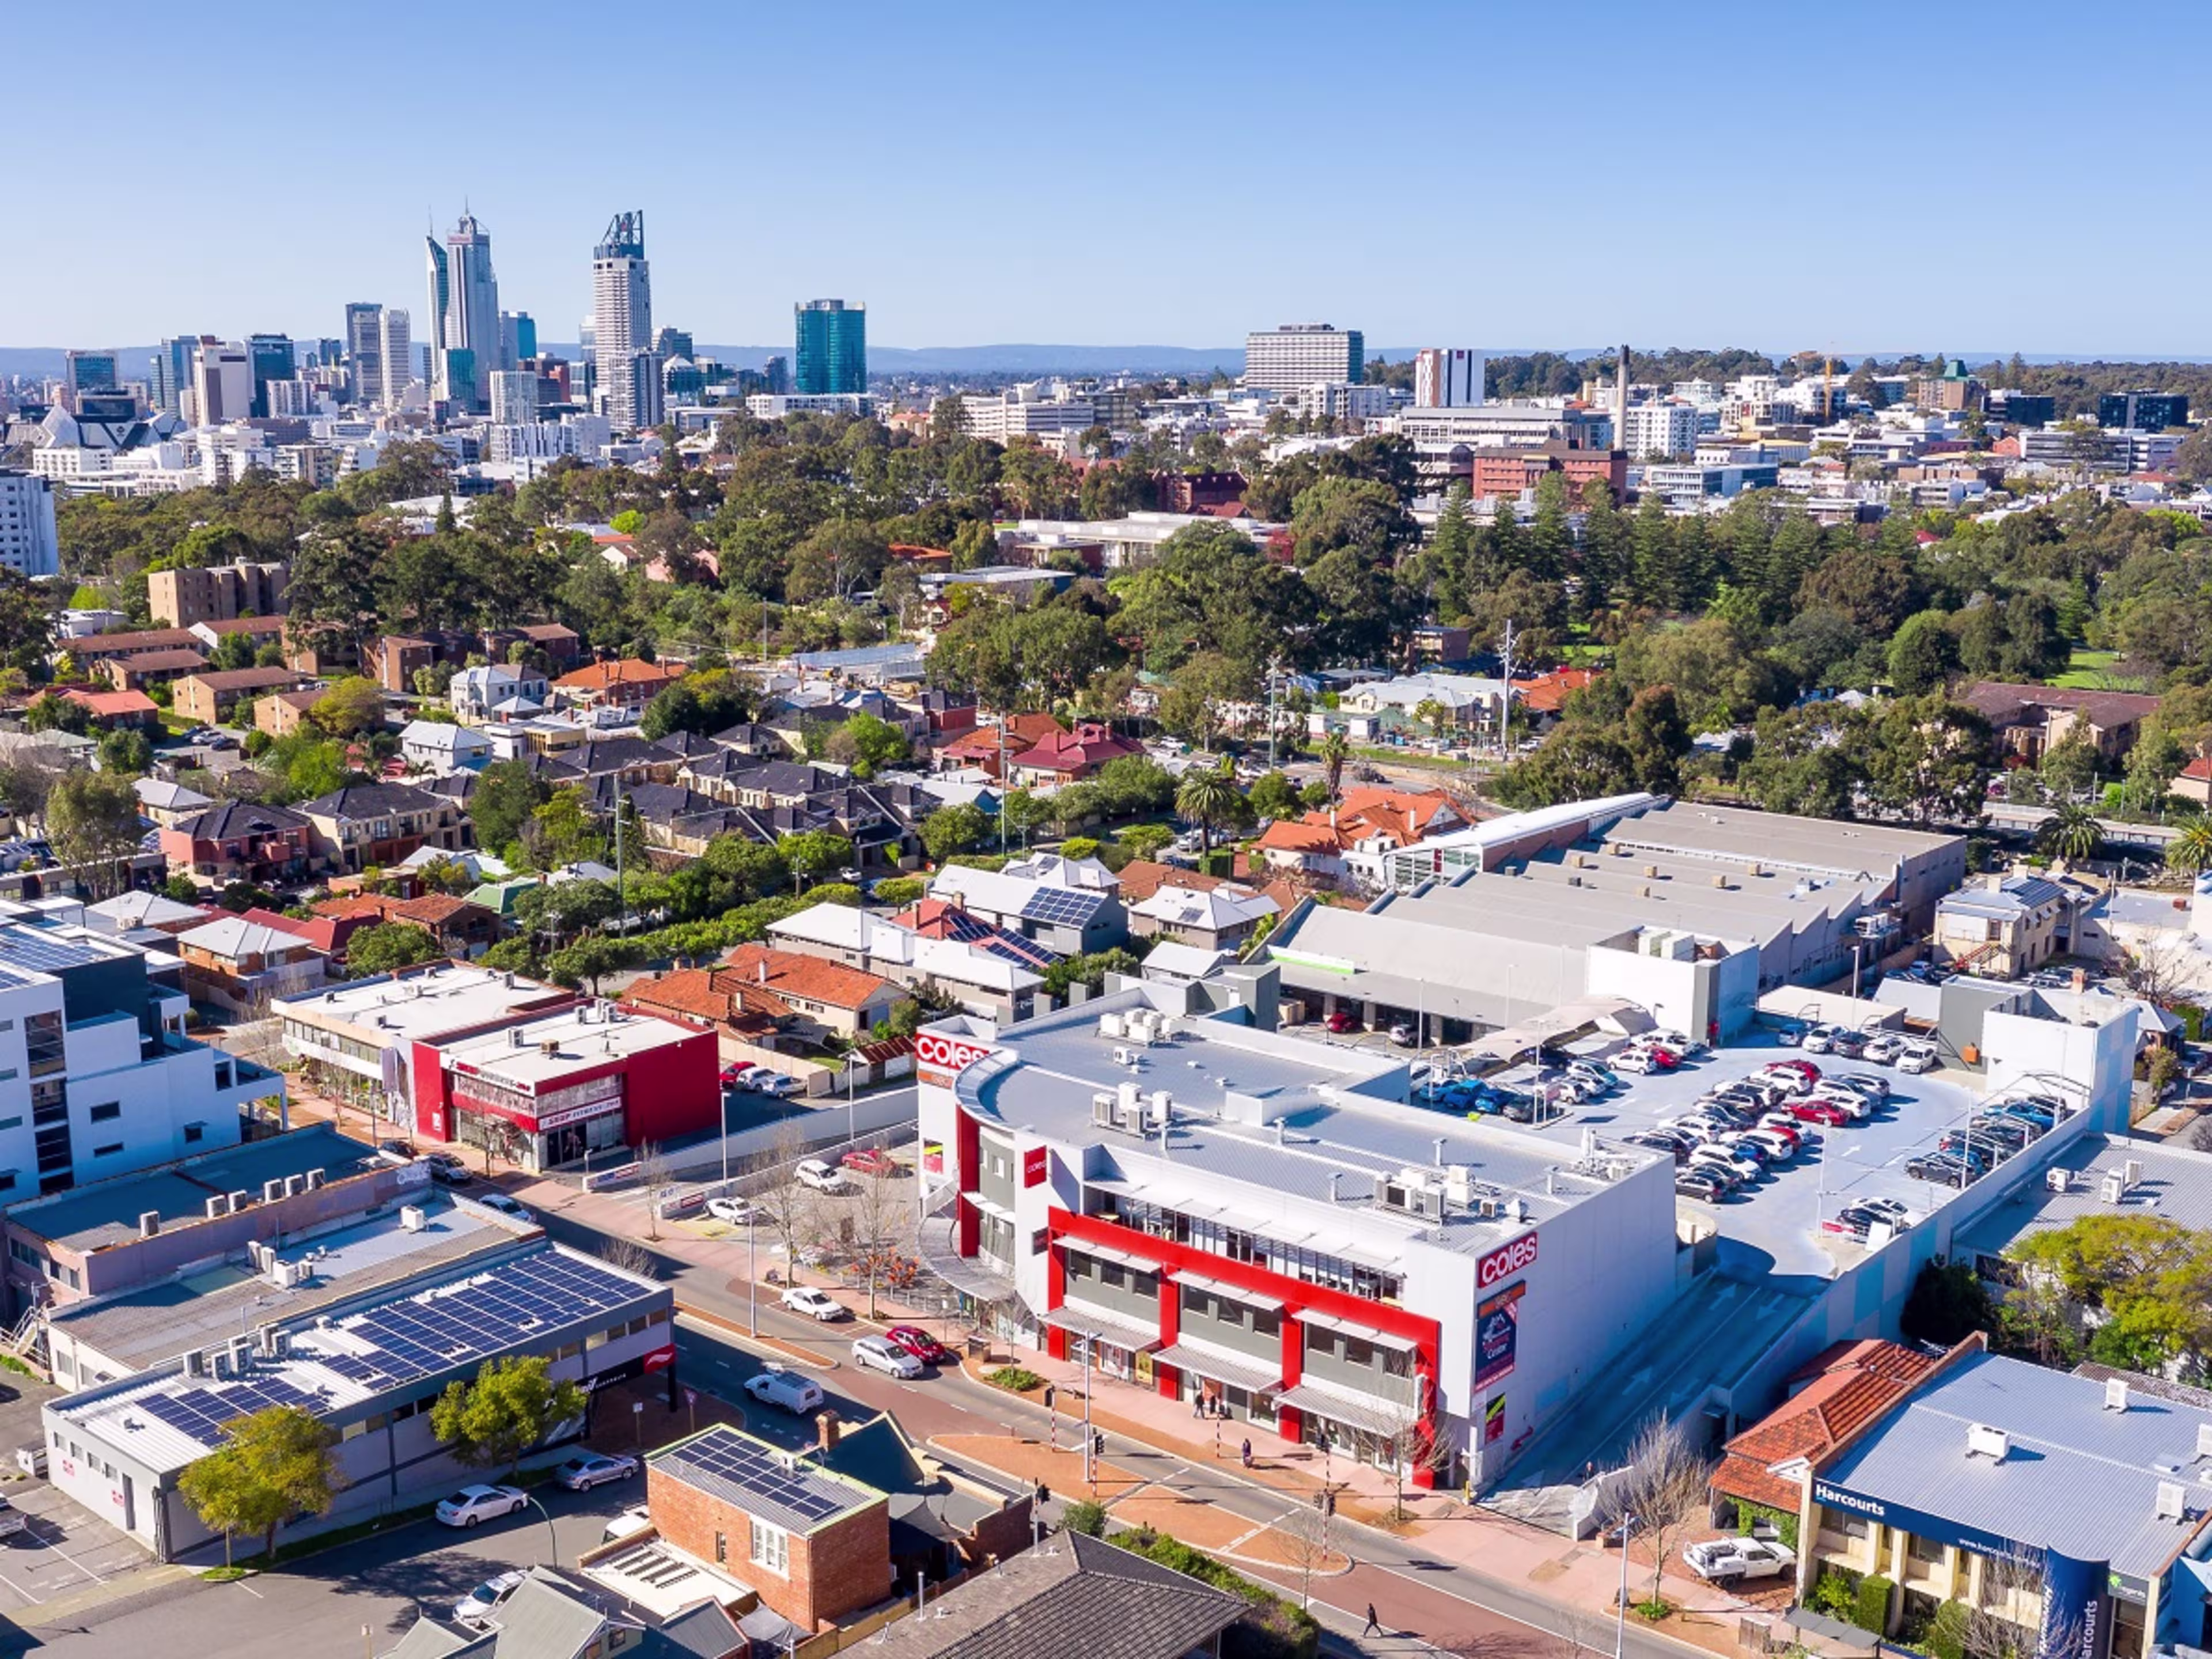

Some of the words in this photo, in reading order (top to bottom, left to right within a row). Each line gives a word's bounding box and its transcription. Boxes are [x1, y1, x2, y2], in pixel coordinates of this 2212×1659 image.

[1482, 1237, 1536, 1283] coles
[1816, 1484, 1885, 1517] Harcourts
[2078, 1600, 2098, 1659] arcourts
